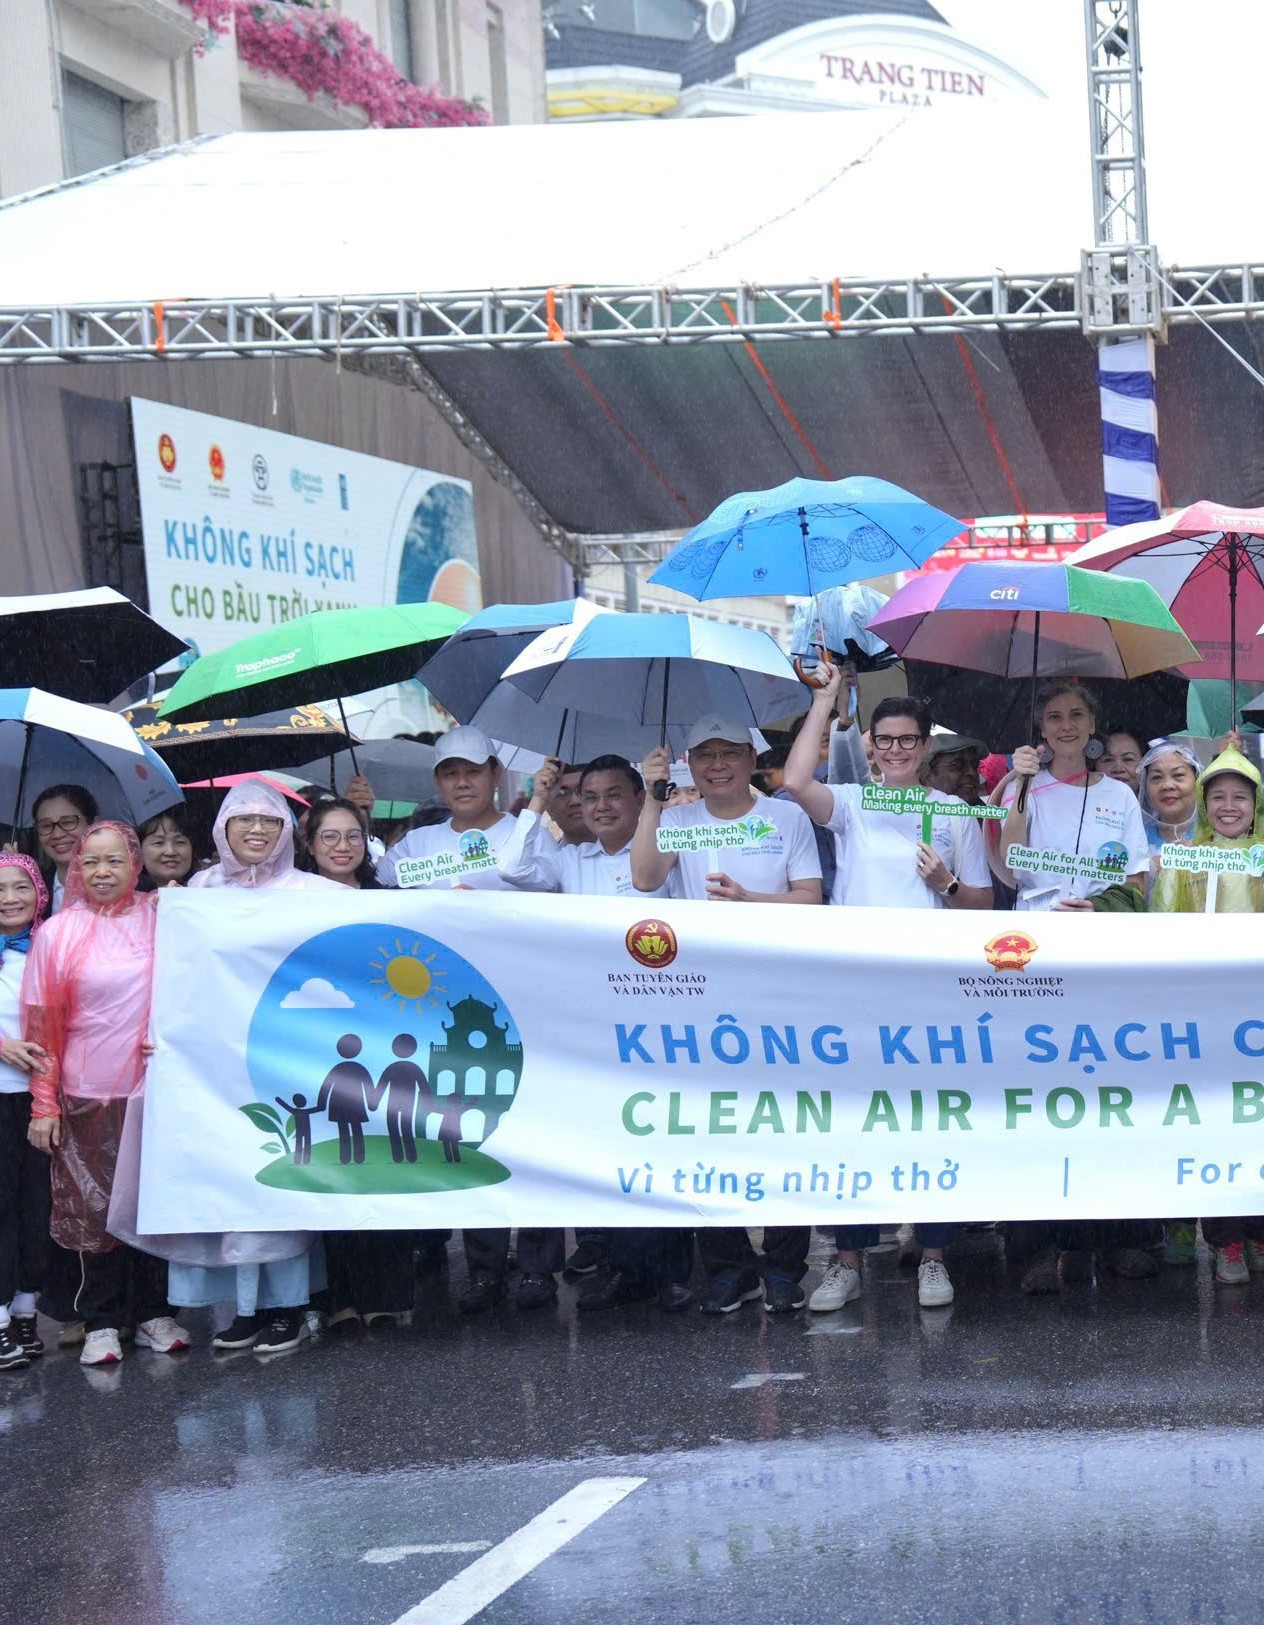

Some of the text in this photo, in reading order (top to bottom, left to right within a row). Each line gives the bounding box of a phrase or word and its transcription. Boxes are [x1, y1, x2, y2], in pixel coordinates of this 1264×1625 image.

[820, 54, 984, 96] TRANG TIEN
[879, 89, 932, 106] PLAZA
[164, 515, 356, 588] KHÔNG KHÍ SẠCH
[171, 583, 215, 620] CHO
[222, 580, 261, 624] BẦU
[990, 588, 1019, 600] citi
[863, 786, 924, 801] Clean Air
[862, 800, 1007, 818] Making every breath matter
[659, 825, 738, 840] Không khí sạch
[660, 835, 745, 851] vì từng nhịp thở
[1010, 846, 1094, 867] Clean Air for All
[1163, 846, 1241, 862] Không khí sạch
[398, 853, 454, 874] Clean Air
[401, 857, 498, 884] Every breath matt
[1008, 857, 1124, 882] Every breath matters
[1162, 858, 1247, 872] vì từng nhịp thở
[608, 972, 706, 983] BAN TUYÊN GIÁO
[958, 975, 1063, 987] BỘ NÔNG NGHIỆP
[613, 984, 705, 997] VÀ DÂN VẬN TW
[964, 986, 1064, 997] VÀ MÔI TRƯỜNG
[614, 1014, 849, 1065] KHÔNG
[878, 1011, 995, 1065] KHÍ
[1023, 1021, 1201, 1074] SẠCH
[621, 1090, 832, 1136] CLEAN
[861, 1088, 973, 1133] AIR
[1003, 1085, 1134, 1130] FOR
[1162, 1083, 1201, 1126] A
[617, 1158, 961, 1202] Vì từng nhịp thở
[1175, 1157, 1242, 1186] For
